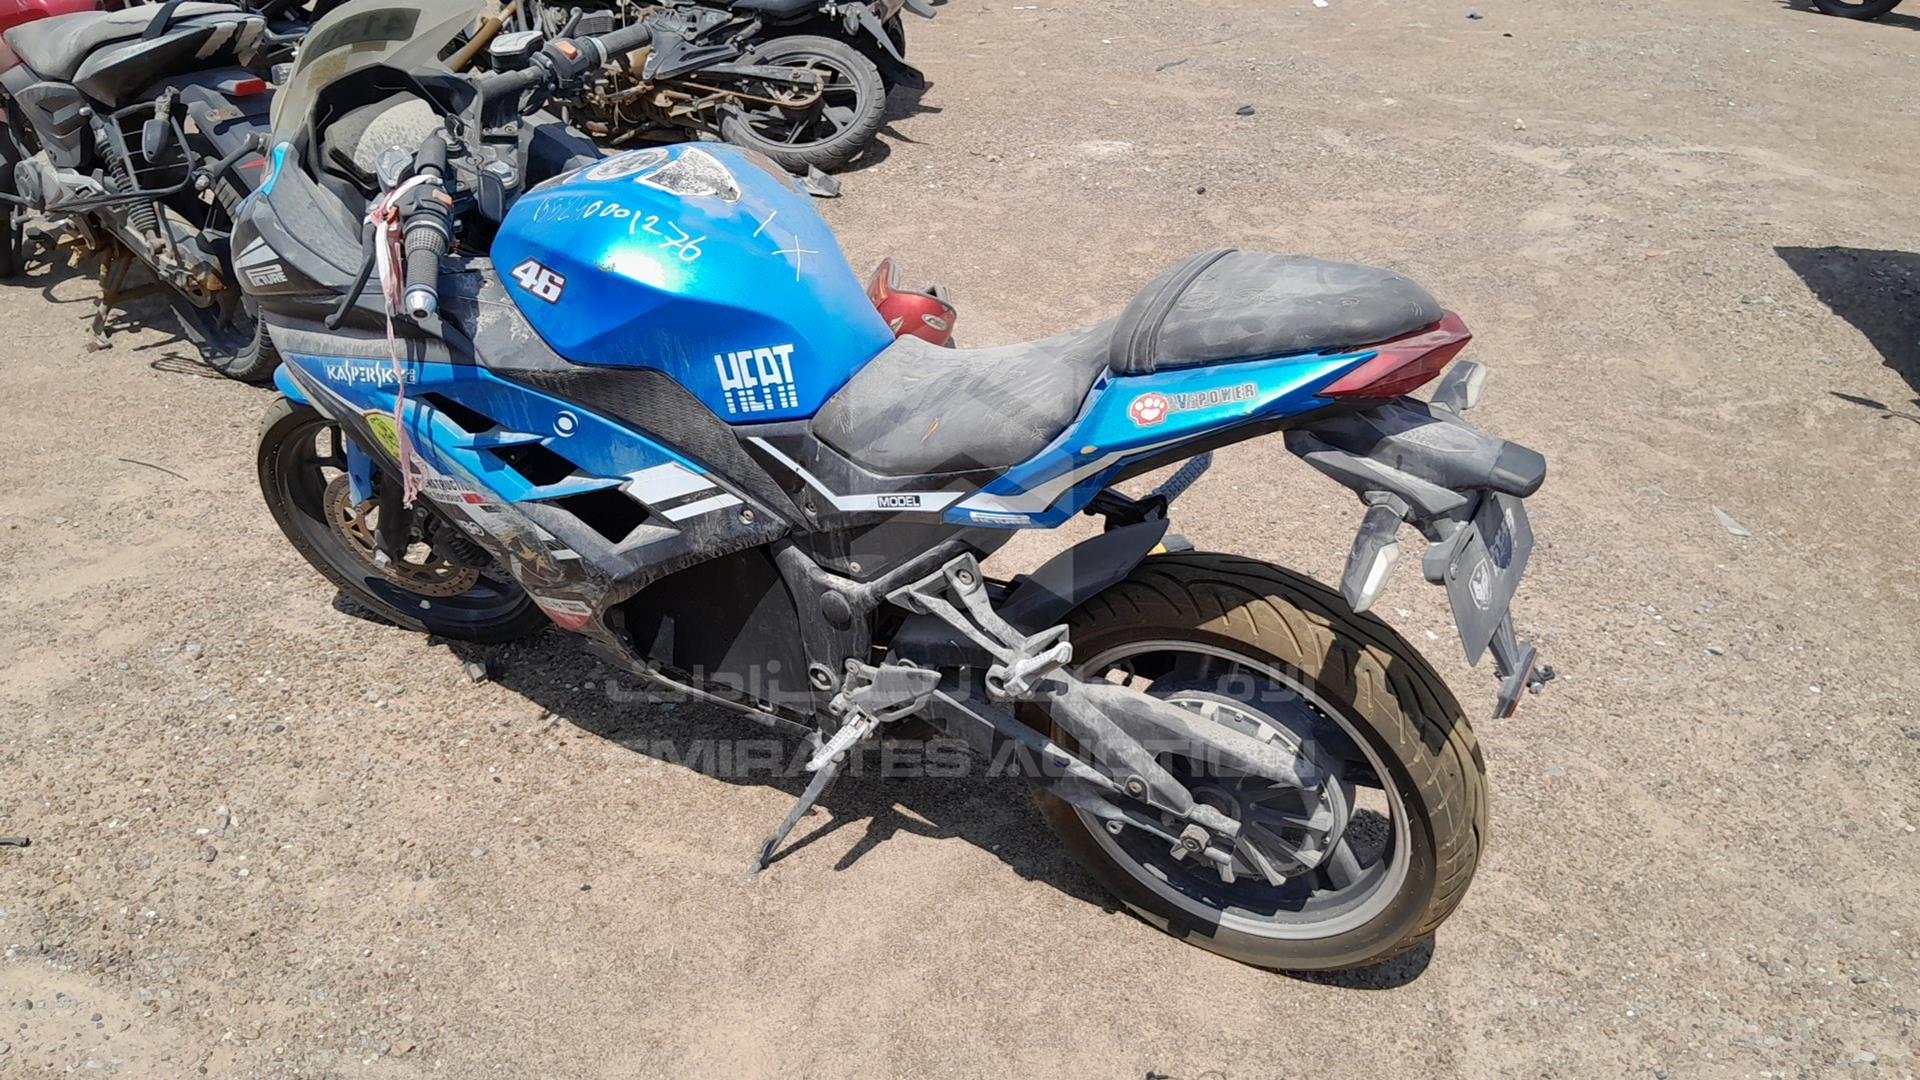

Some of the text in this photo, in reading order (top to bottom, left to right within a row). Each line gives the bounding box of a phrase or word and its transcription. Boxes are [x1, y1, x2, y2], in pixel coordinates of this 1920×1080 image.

[511, 258, 565, 303] 46
[326, 359, 405, 388] KASPERSKY
[878, 496, 921, 508] MODEL
